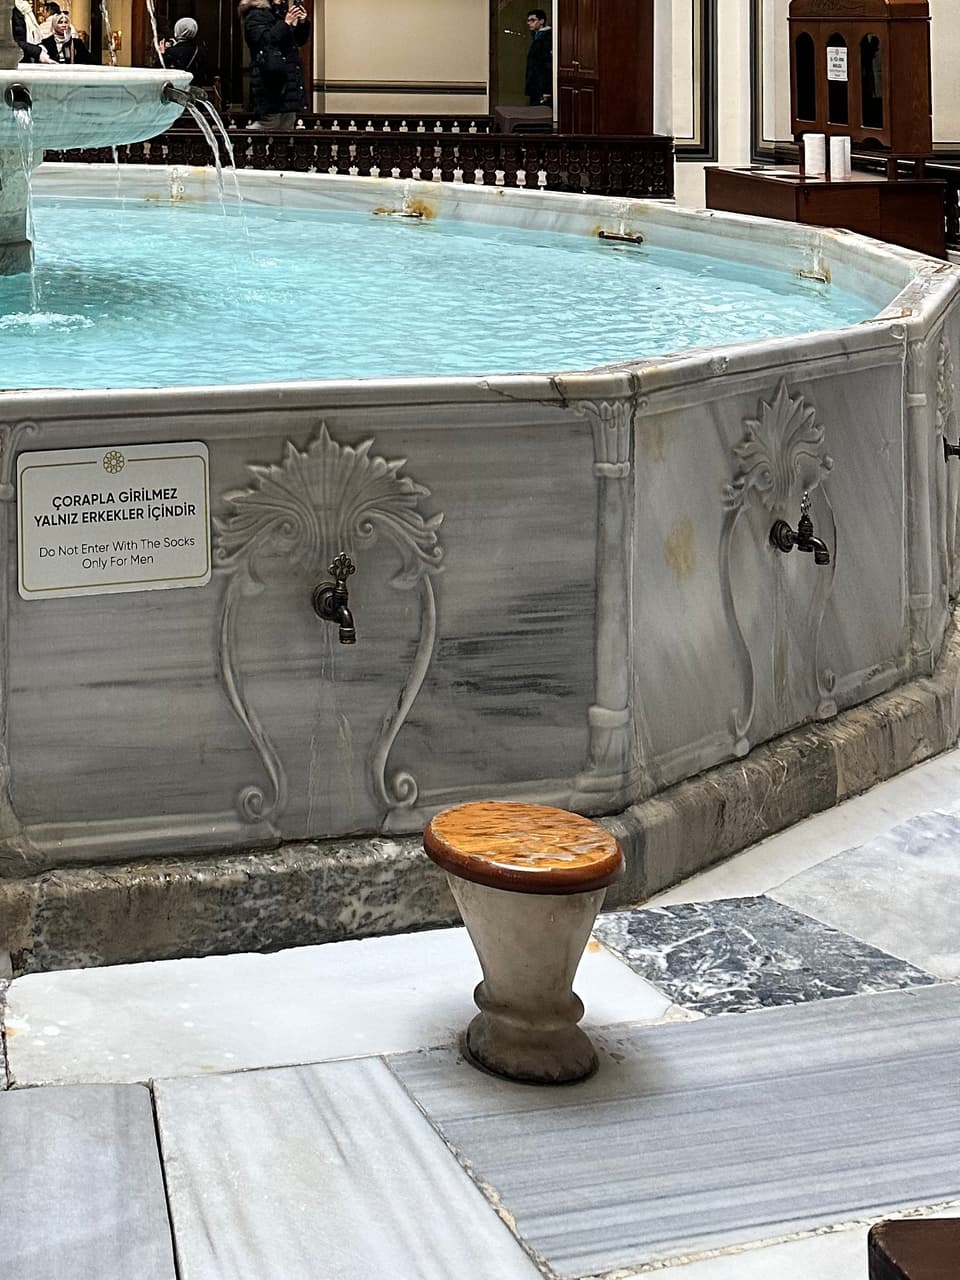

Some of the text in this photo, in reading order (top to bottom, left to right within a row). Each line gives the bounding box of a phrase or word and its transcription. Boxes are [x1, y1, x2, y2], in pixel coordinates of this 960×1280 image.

[52, 487, 178, 510] ÇORAPLA GİRİLMEZ
[34, 501, 196, 528] YALNIZ ERKEKLER İÇİNDİR
[39, 536, 196, 558] Do Not Enter With The Socks
[82, 554, 154, 570] Only For Men
